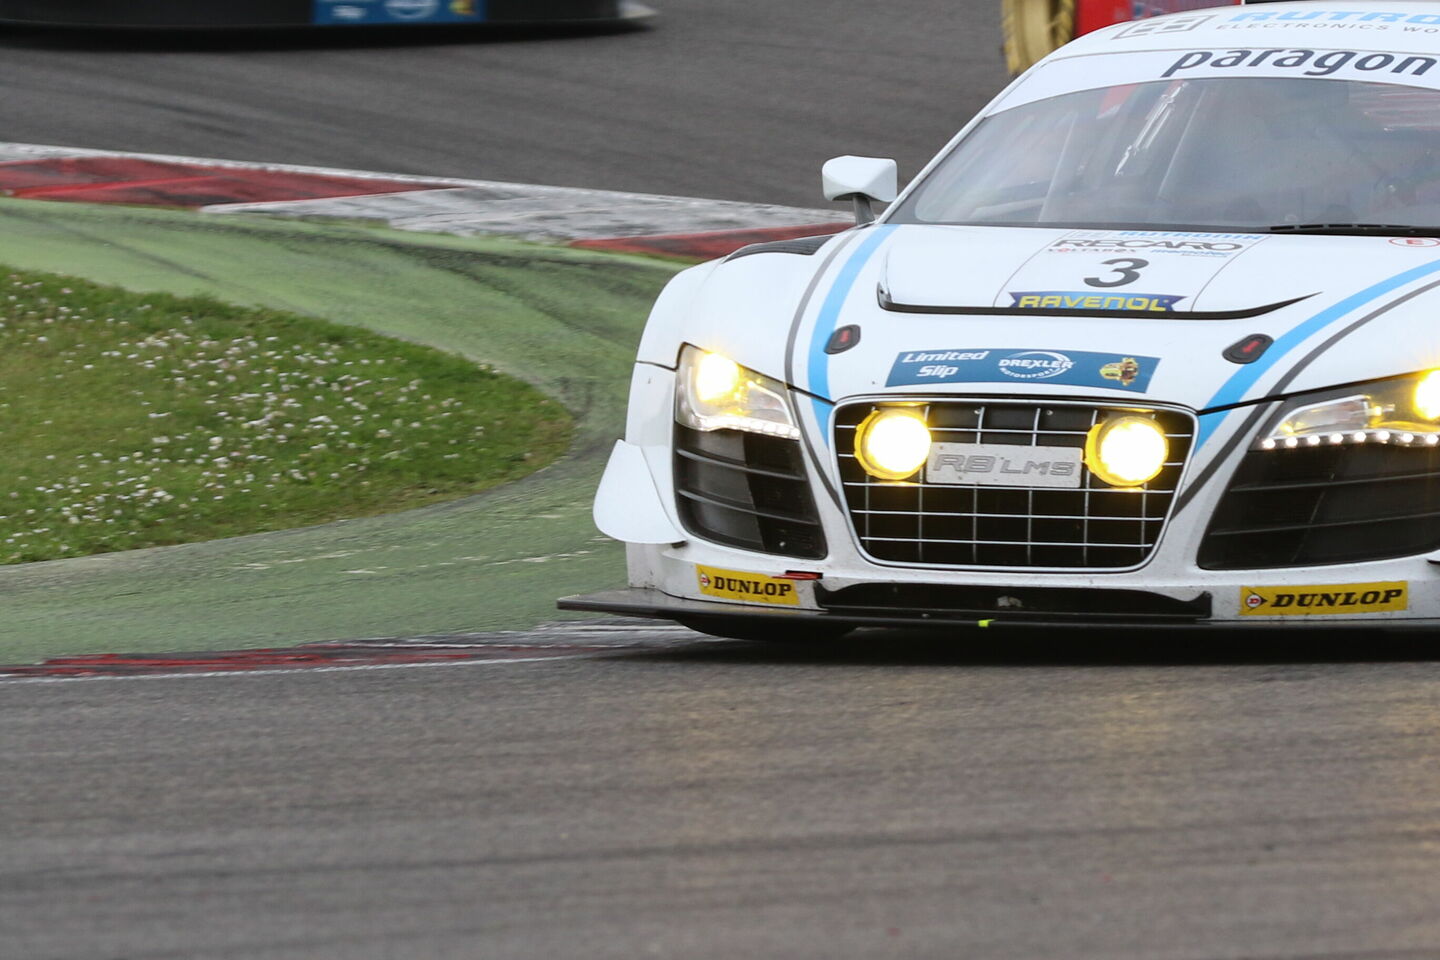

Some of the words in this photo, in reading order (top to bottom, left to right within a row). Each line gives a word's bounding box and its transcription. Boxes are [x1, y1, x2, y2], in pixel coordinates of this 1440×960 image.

[1215, 21, 1390, 31] ELECTRONICS
[1159, 49, 1438, 78] paragon
[1053, 239, 1243, 252] RECARO
[1083, 257, 1150, 288] 3
[1017, 295, 1169, 312] RAVENOL
[902, 351, 990, 363] Limited
[998, 358, 1076, 370] DREXLER
[916, 365, 960, 378] Slip
[1000, 460, 1076, 477] LMS
[713, 576, 792, 596] DUNLOP
[1270, 589, 1403, 608] DUNLOP
